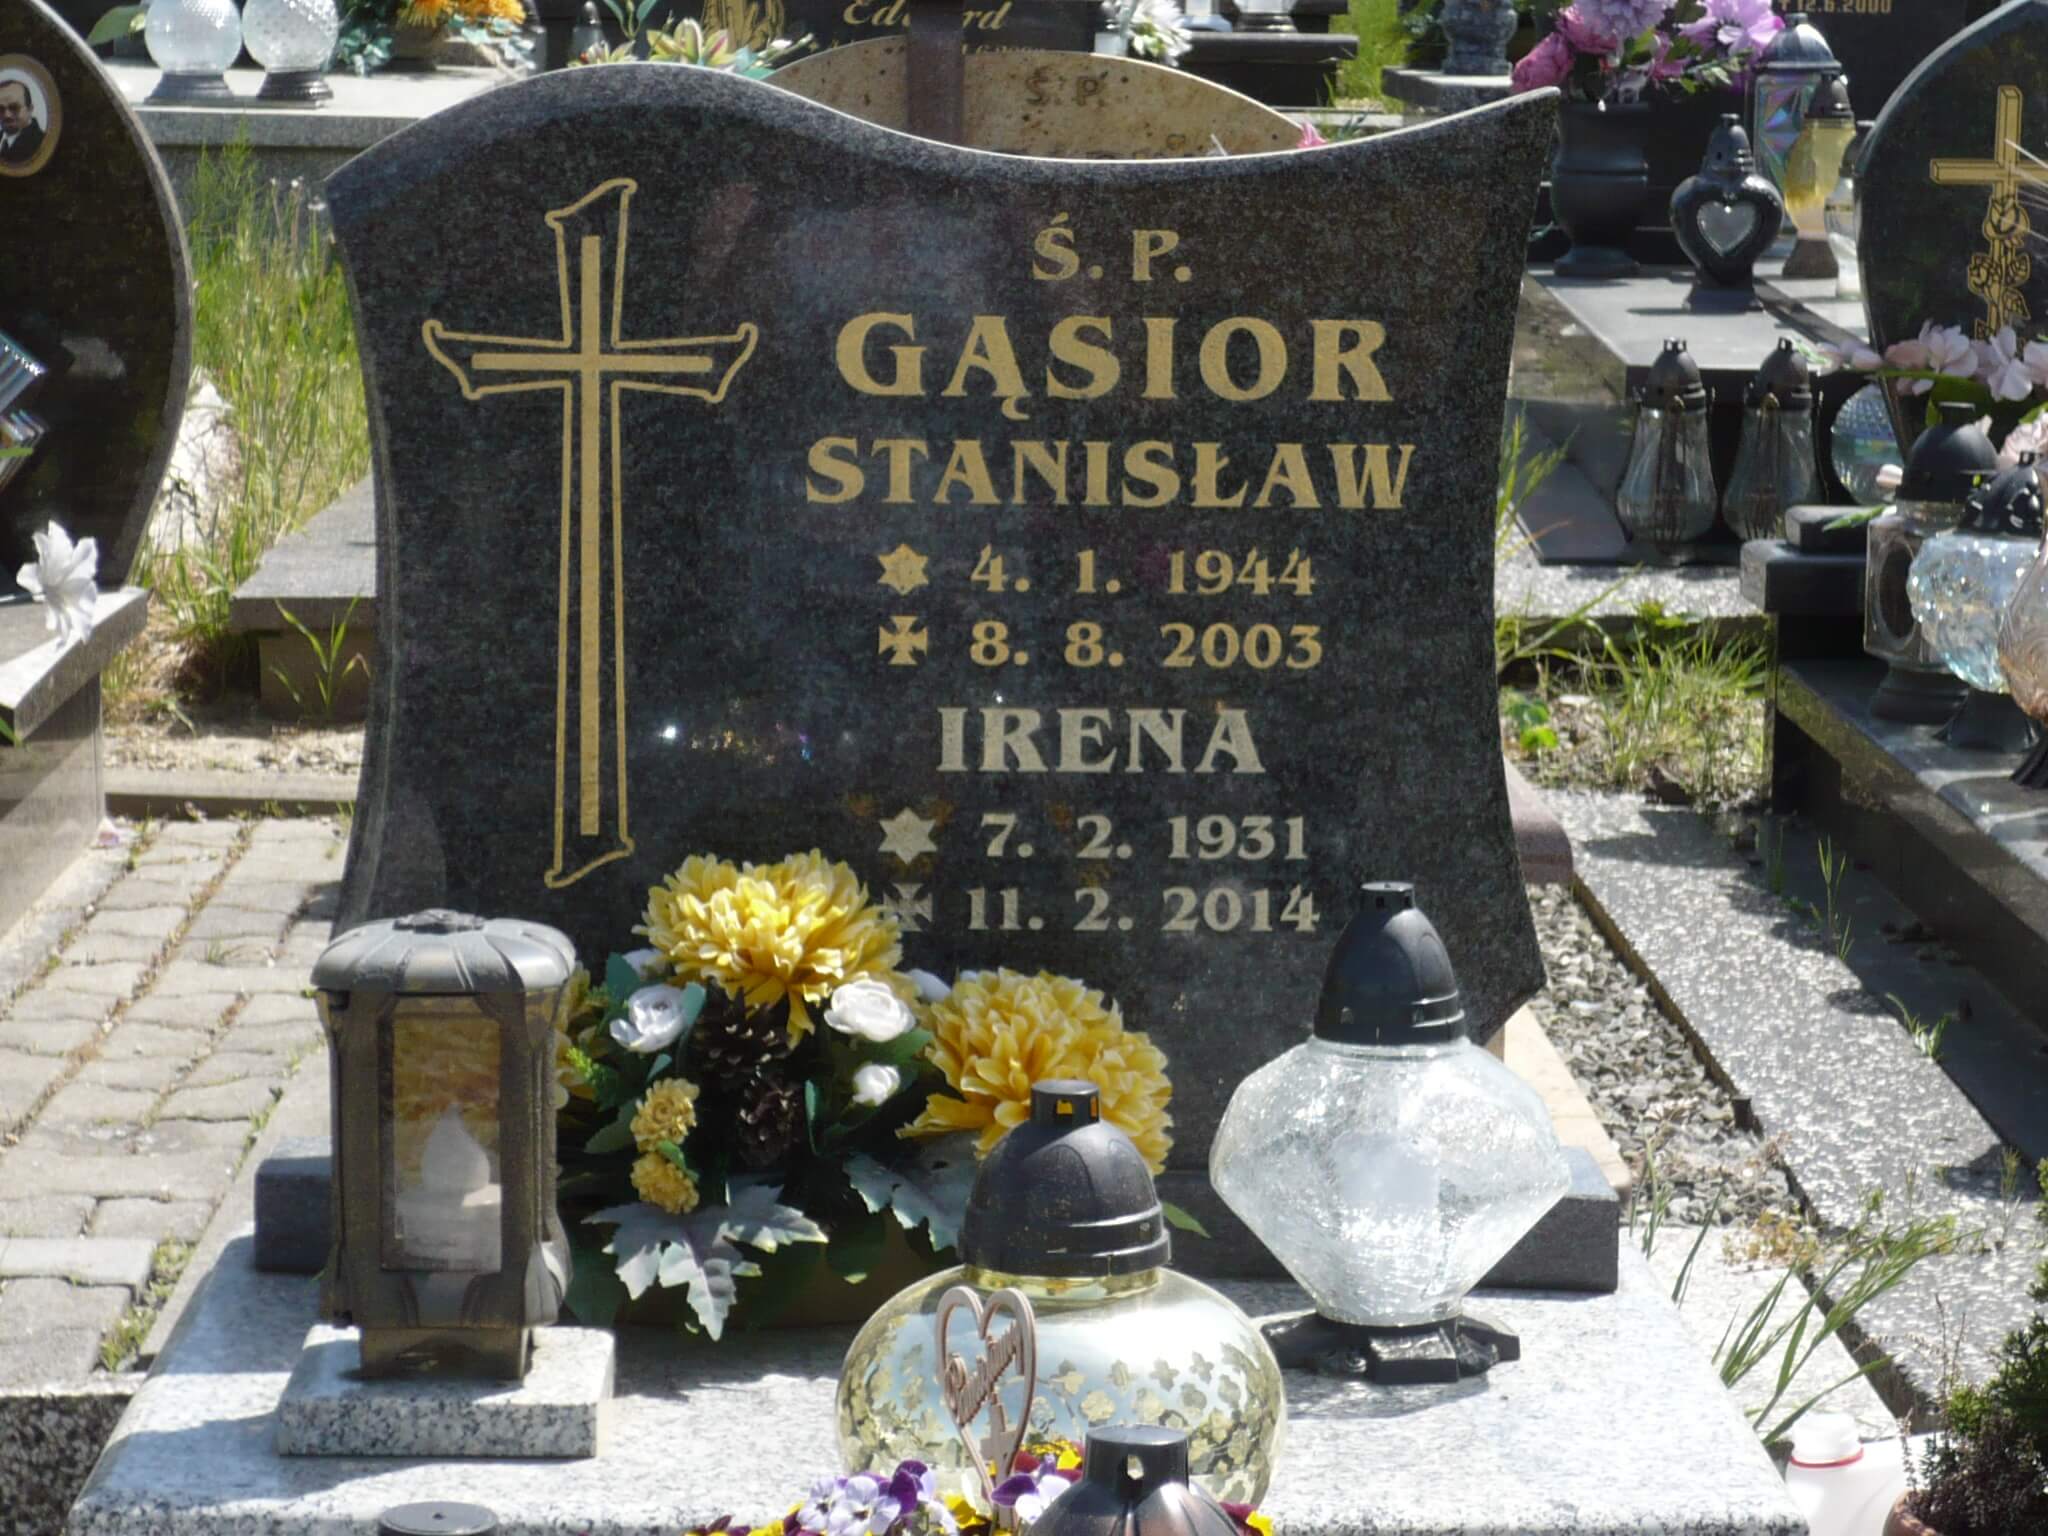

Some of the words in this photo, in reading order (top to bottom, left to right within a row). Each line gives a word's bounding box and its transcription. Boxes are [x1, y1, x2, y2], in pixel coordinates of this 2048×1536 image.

[1032, 211, 1104, 282] Ś.
[1132, 229, 1193, 283] P.
[835, 312, 1394, 420] GĄSIOR
[806, 436, 1417, 509] STANISŁAW
[970, 543, 1030, 593] 4.
[1076, 549, 1121, 594] 1.
[1167, 546, 1316, 596] 1944
[970, 620, 1030, 666] 8.
[1064, 621, 1124, 667] 8.
[1160, 622, 1323, 669] 2003
[937, 707, 1266, 774] IRENA
[980, 813, 1033, 859] 7.
[1076, 815, 1133, 860] 2.
[1167, 815, 1308, 860] 1931
[966, 887, 1044, 930] 11.
[1073, 887, 1134, 931] 2.
[1161, 886, 1321, 932] 2014
